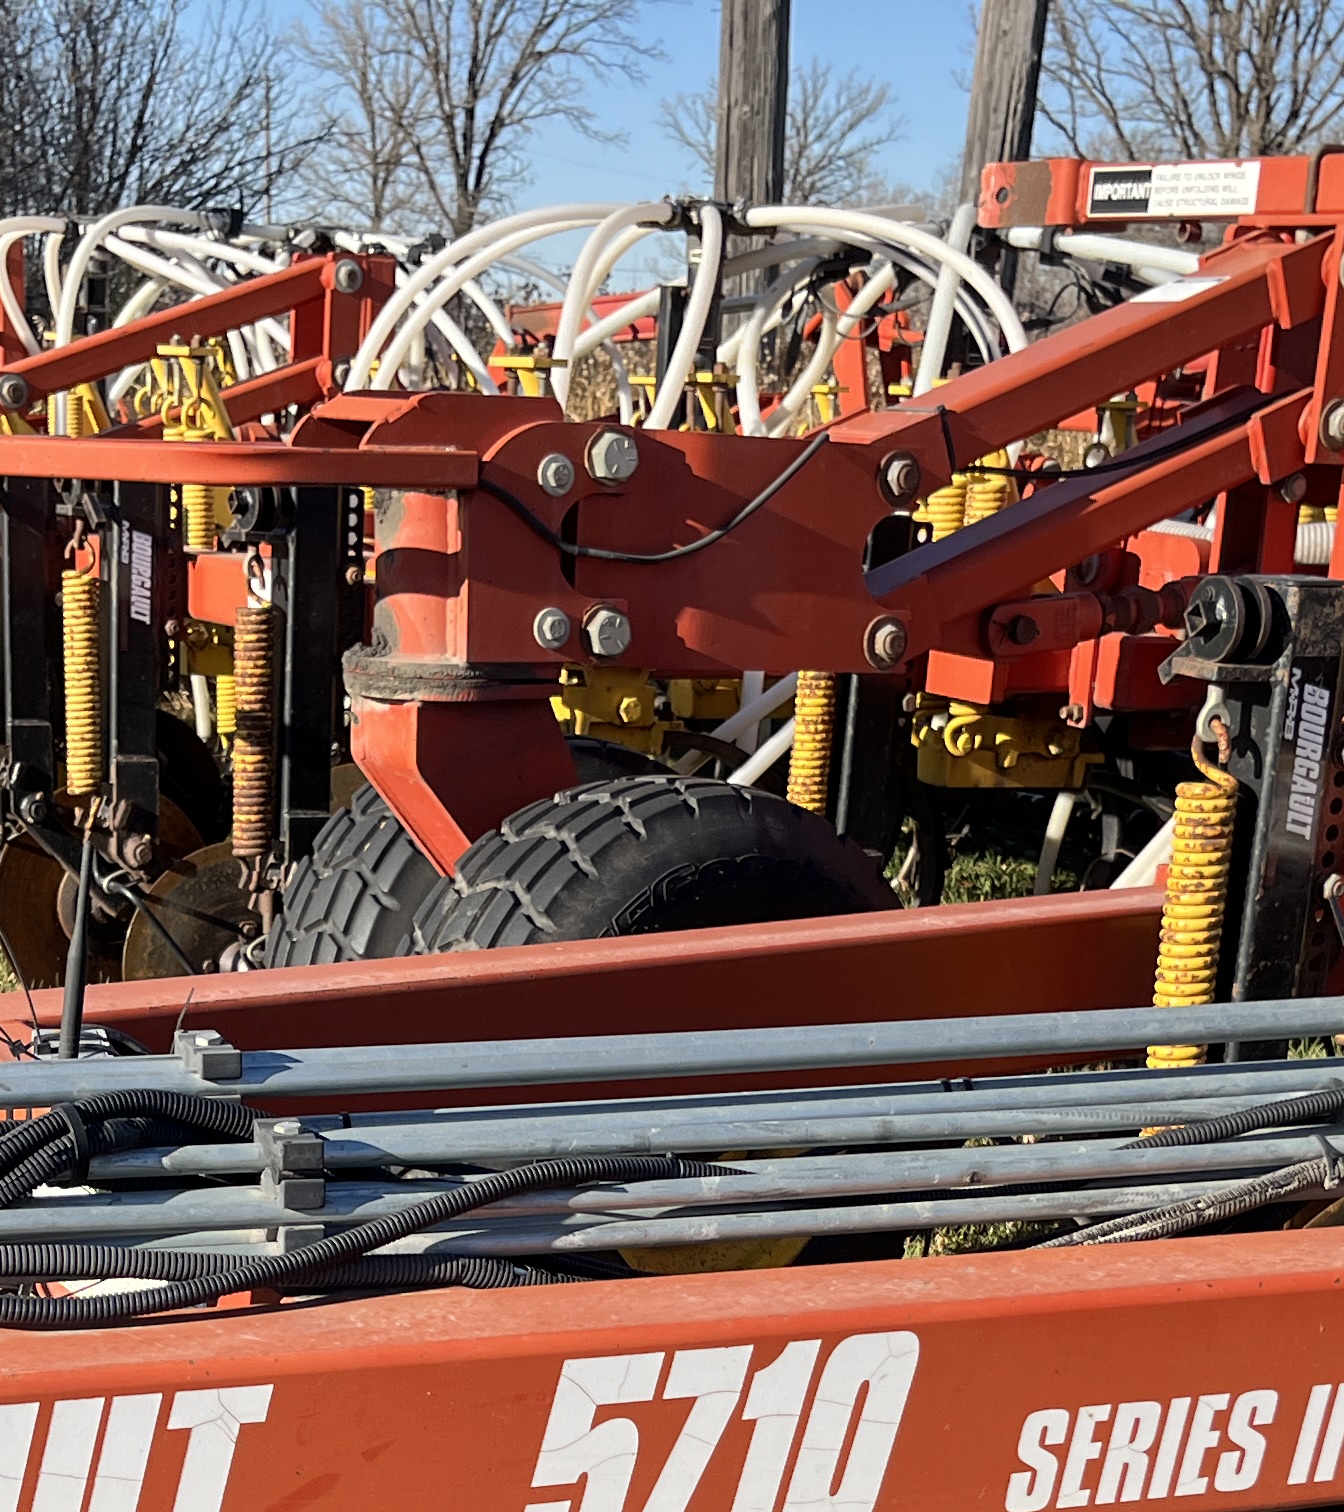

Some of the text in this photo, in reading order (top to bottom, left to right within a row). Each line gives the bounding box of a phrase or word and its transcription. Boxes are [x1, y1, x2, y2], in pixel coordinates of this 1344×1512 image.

[1093, 182, 1152, 200] IMPORTANT
[130, 530, 152, 625] BOURGAULT
[1285, 683, 1330, 841] BOURGAULT
